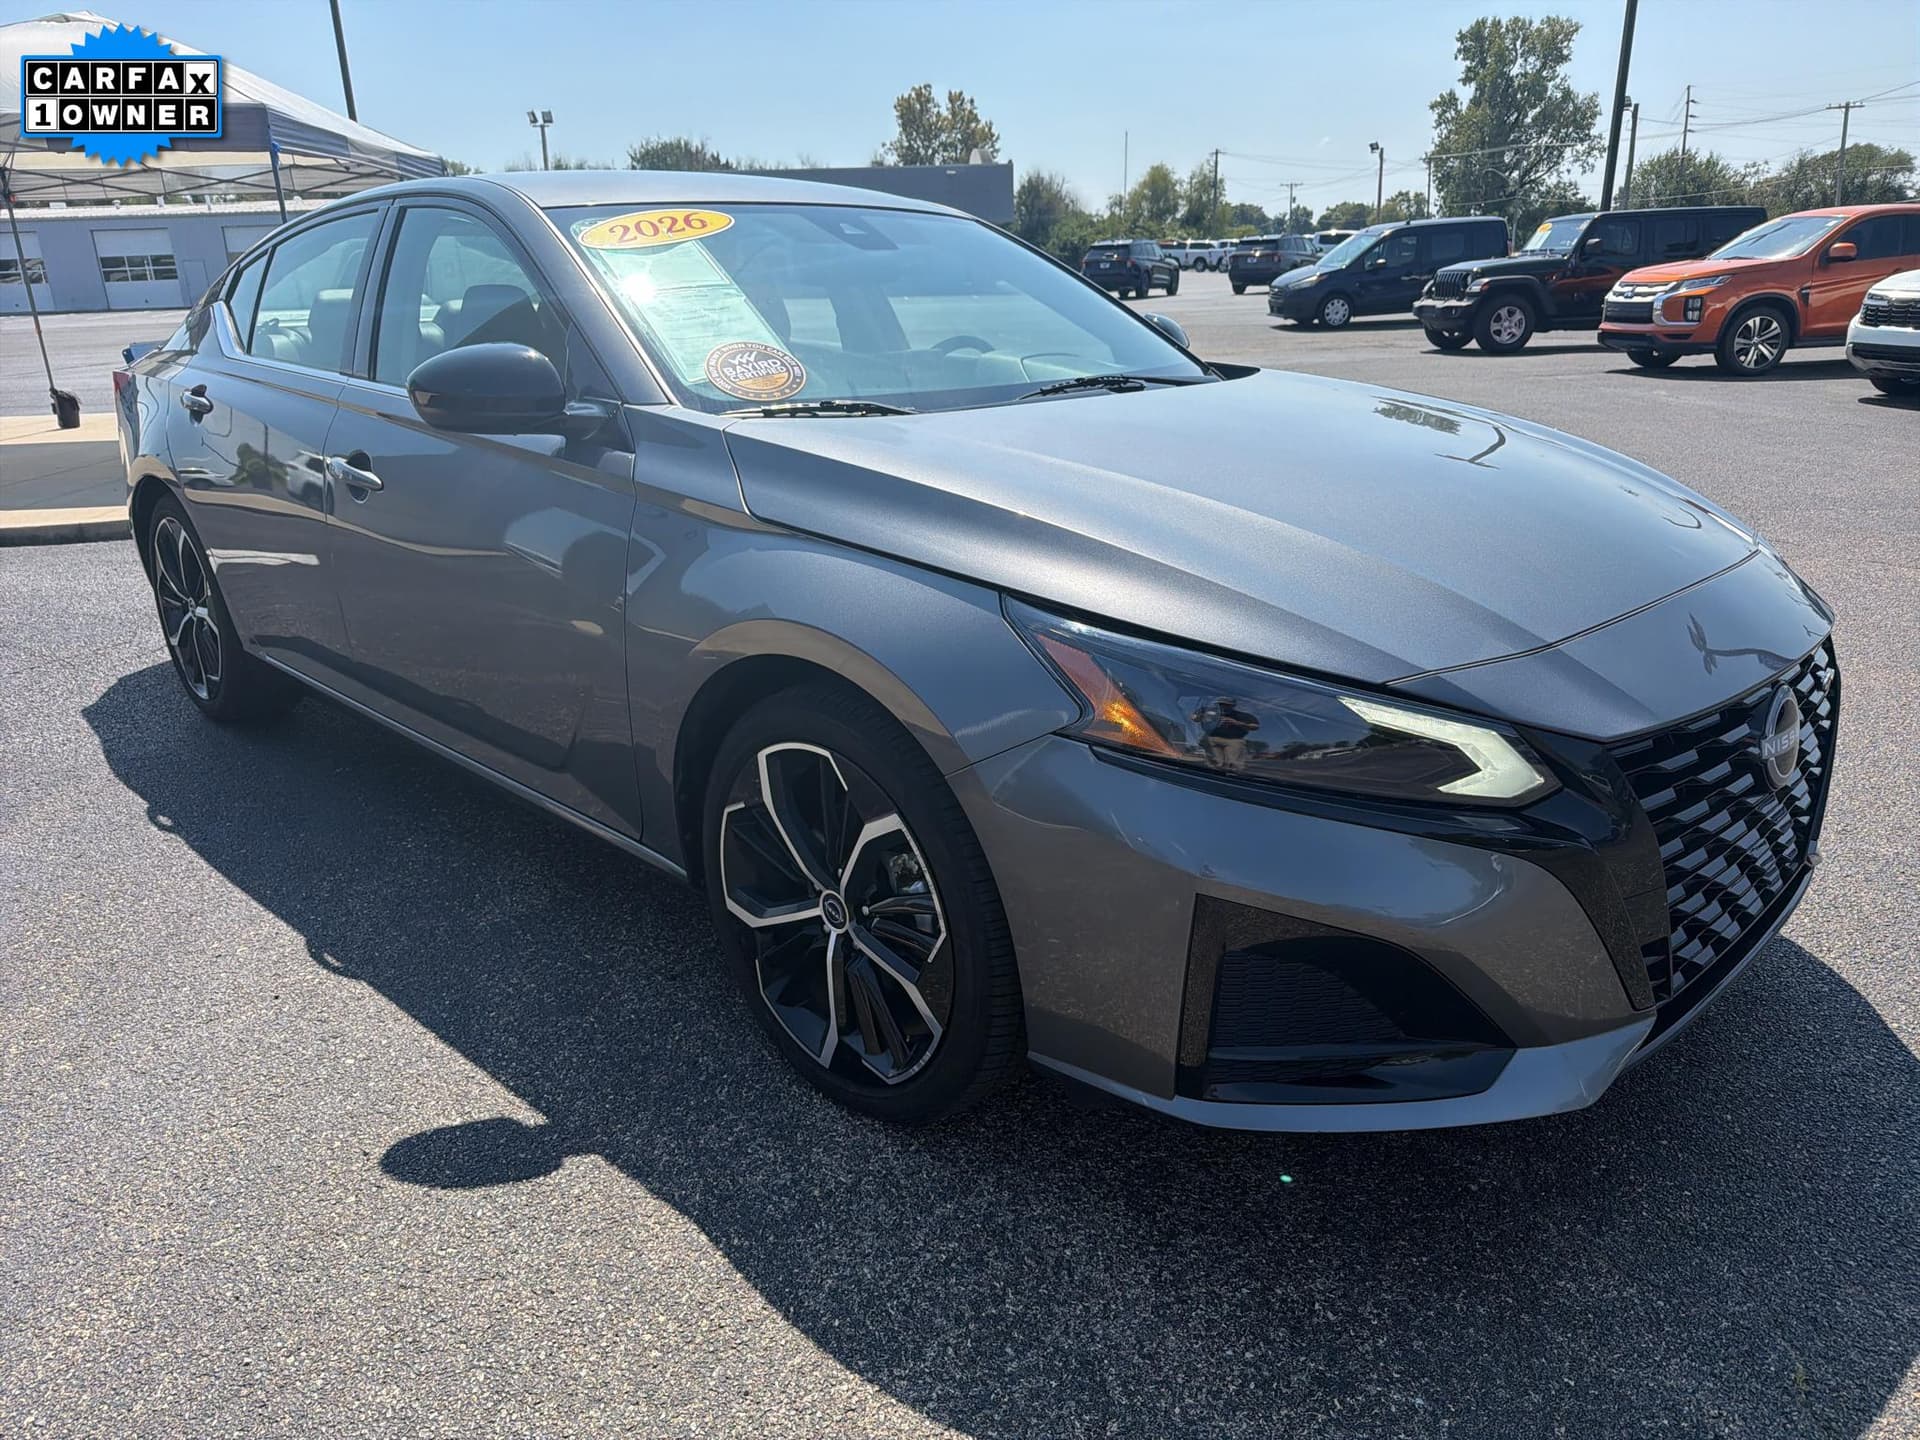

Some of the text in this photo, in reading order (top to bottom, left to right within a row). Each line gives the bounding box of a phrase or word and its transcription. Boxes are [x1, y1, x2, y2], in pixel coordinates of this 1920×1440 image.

[609, 212, 708, 244] 2026
[723, 358, 781, 377] BAYIRD
[730, 366, 787, 382] CERTIFIED
[1764, 729, 1798, 756] NISS
